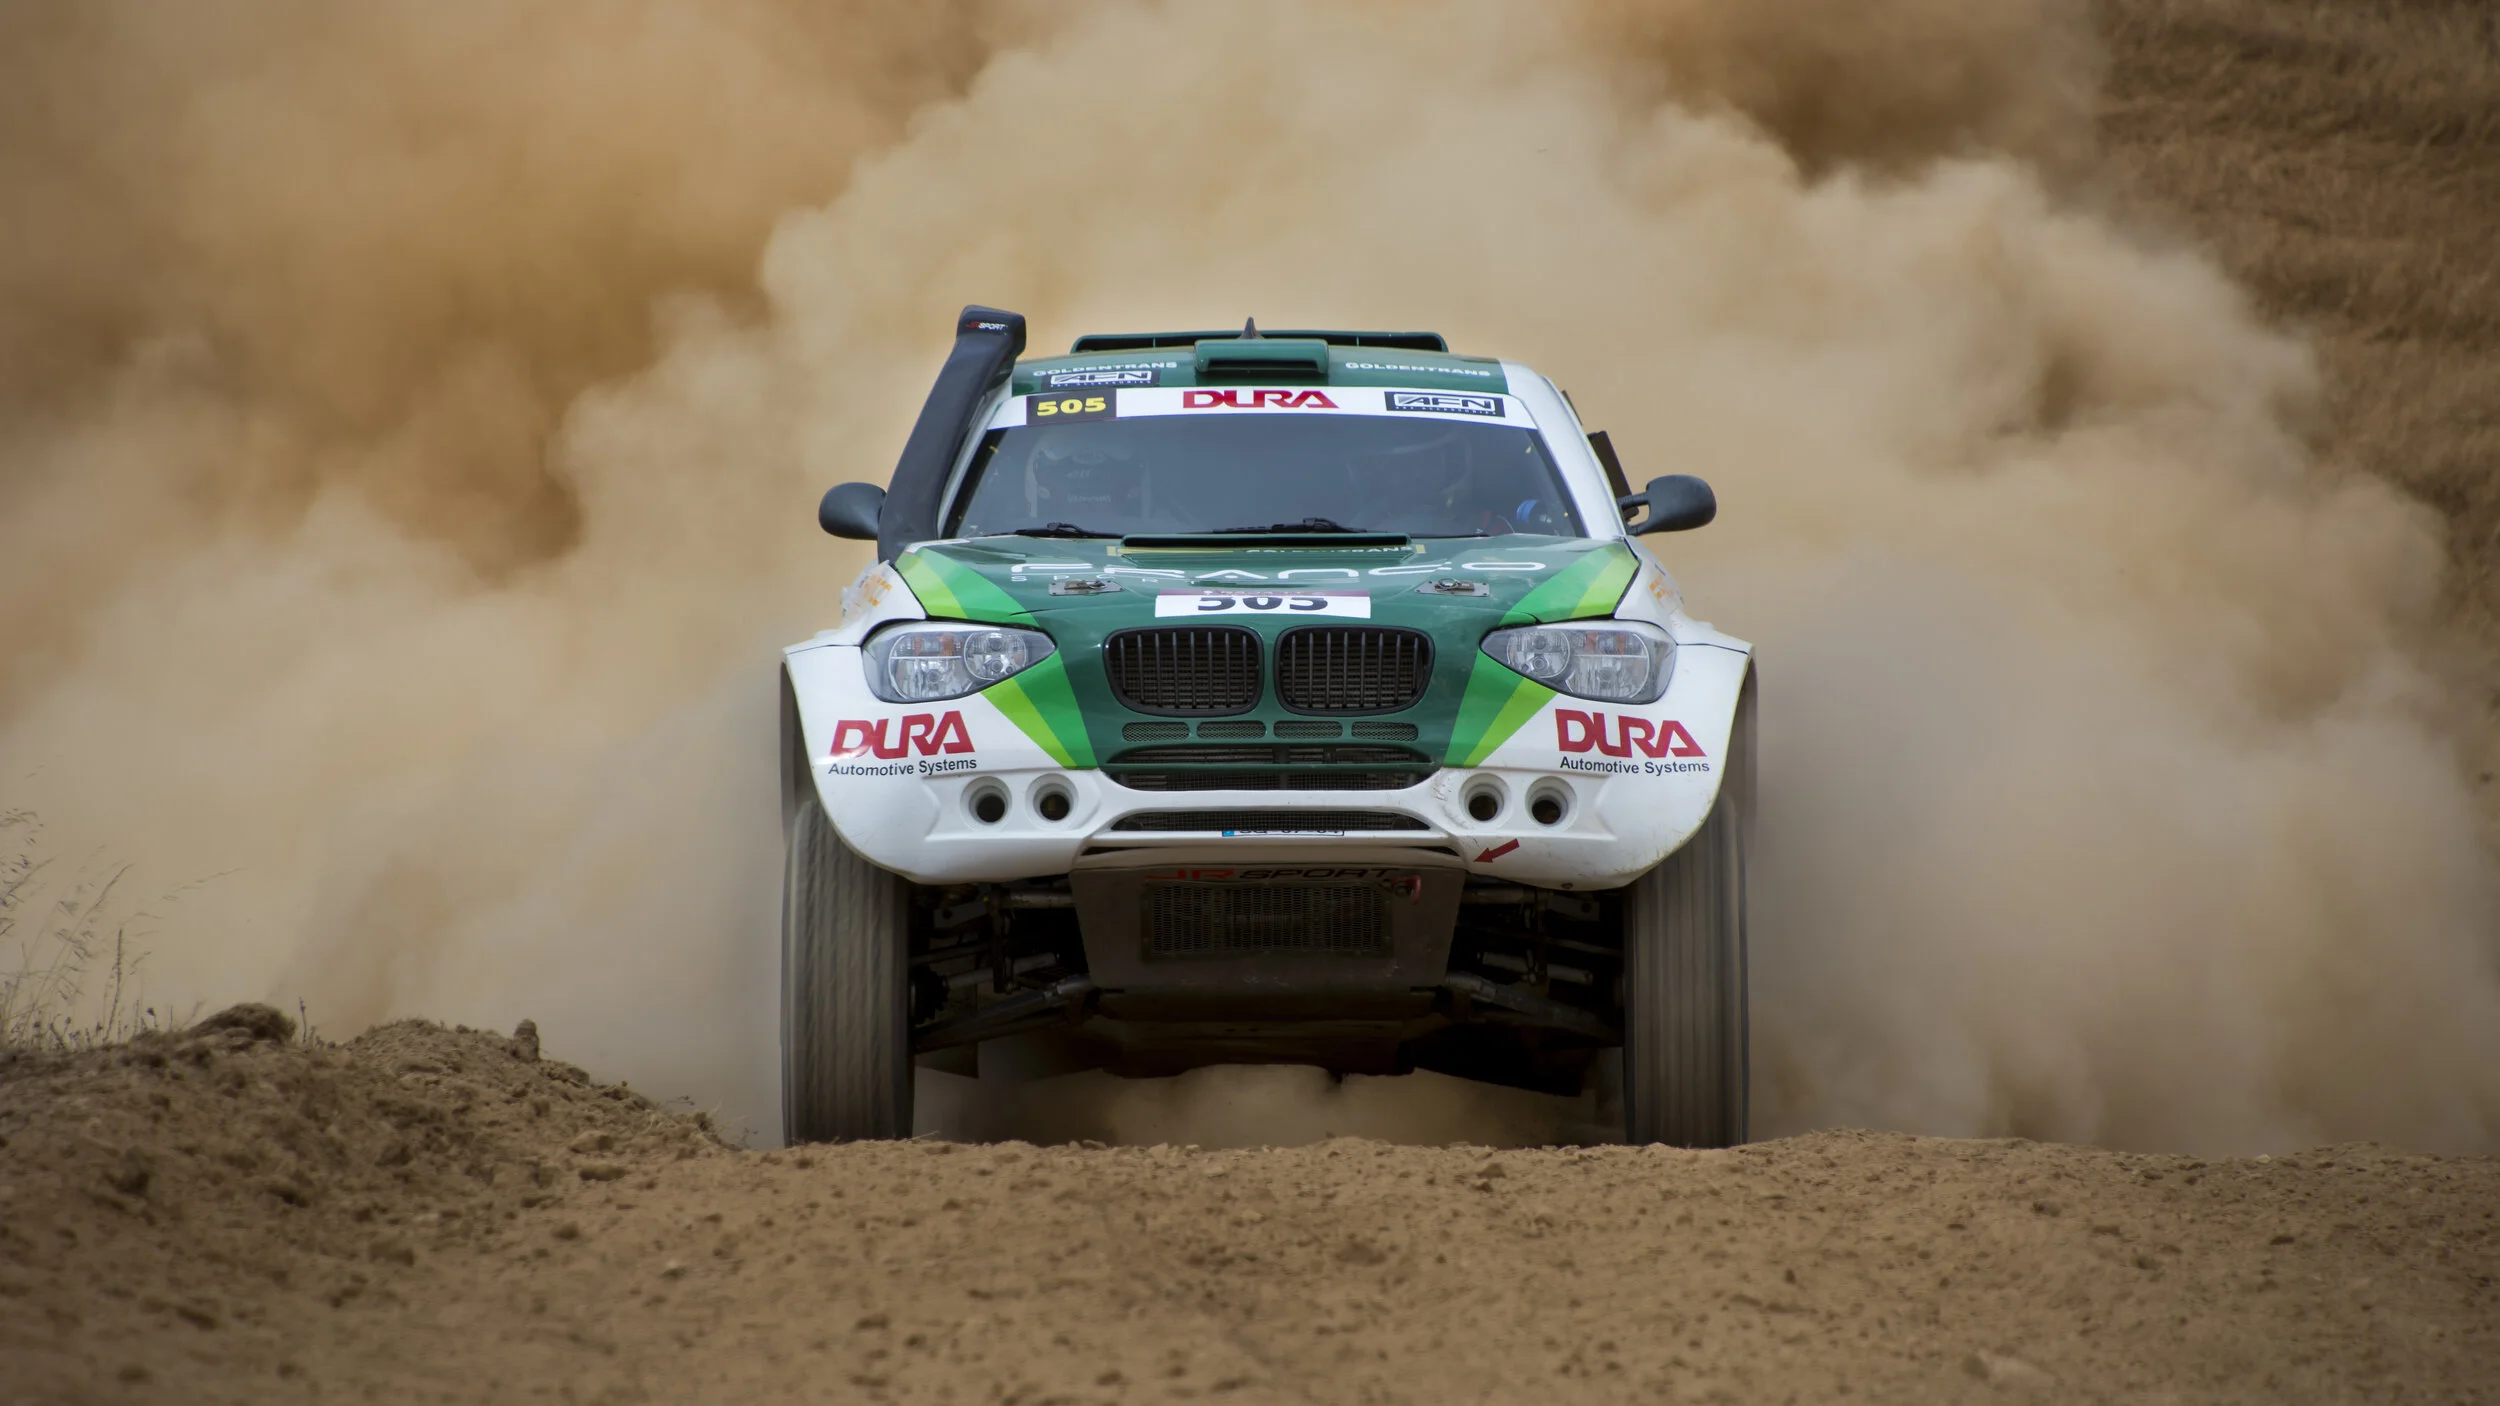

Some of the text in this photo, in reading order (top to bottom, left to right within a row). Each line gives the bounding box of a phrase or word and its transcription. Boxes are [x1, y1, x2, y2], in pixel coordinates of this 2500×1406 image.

[1033, 361, 1178, 377] GOLDENTRANS
[1345, 362, 1491, 377] GOLDENTRANS
[1037, 397, 1107, 417] 505
[1183, 390, 1338, 408] DURA
[830, 710, 975, 760] DURA
[1555, 709, 1707, 759] DURA
[828, 759, 977, 776] Automotive Systems
[1560, 756, 1710, 776] Automotive Systems
[1239, 868, 1400, 880] SPORT
